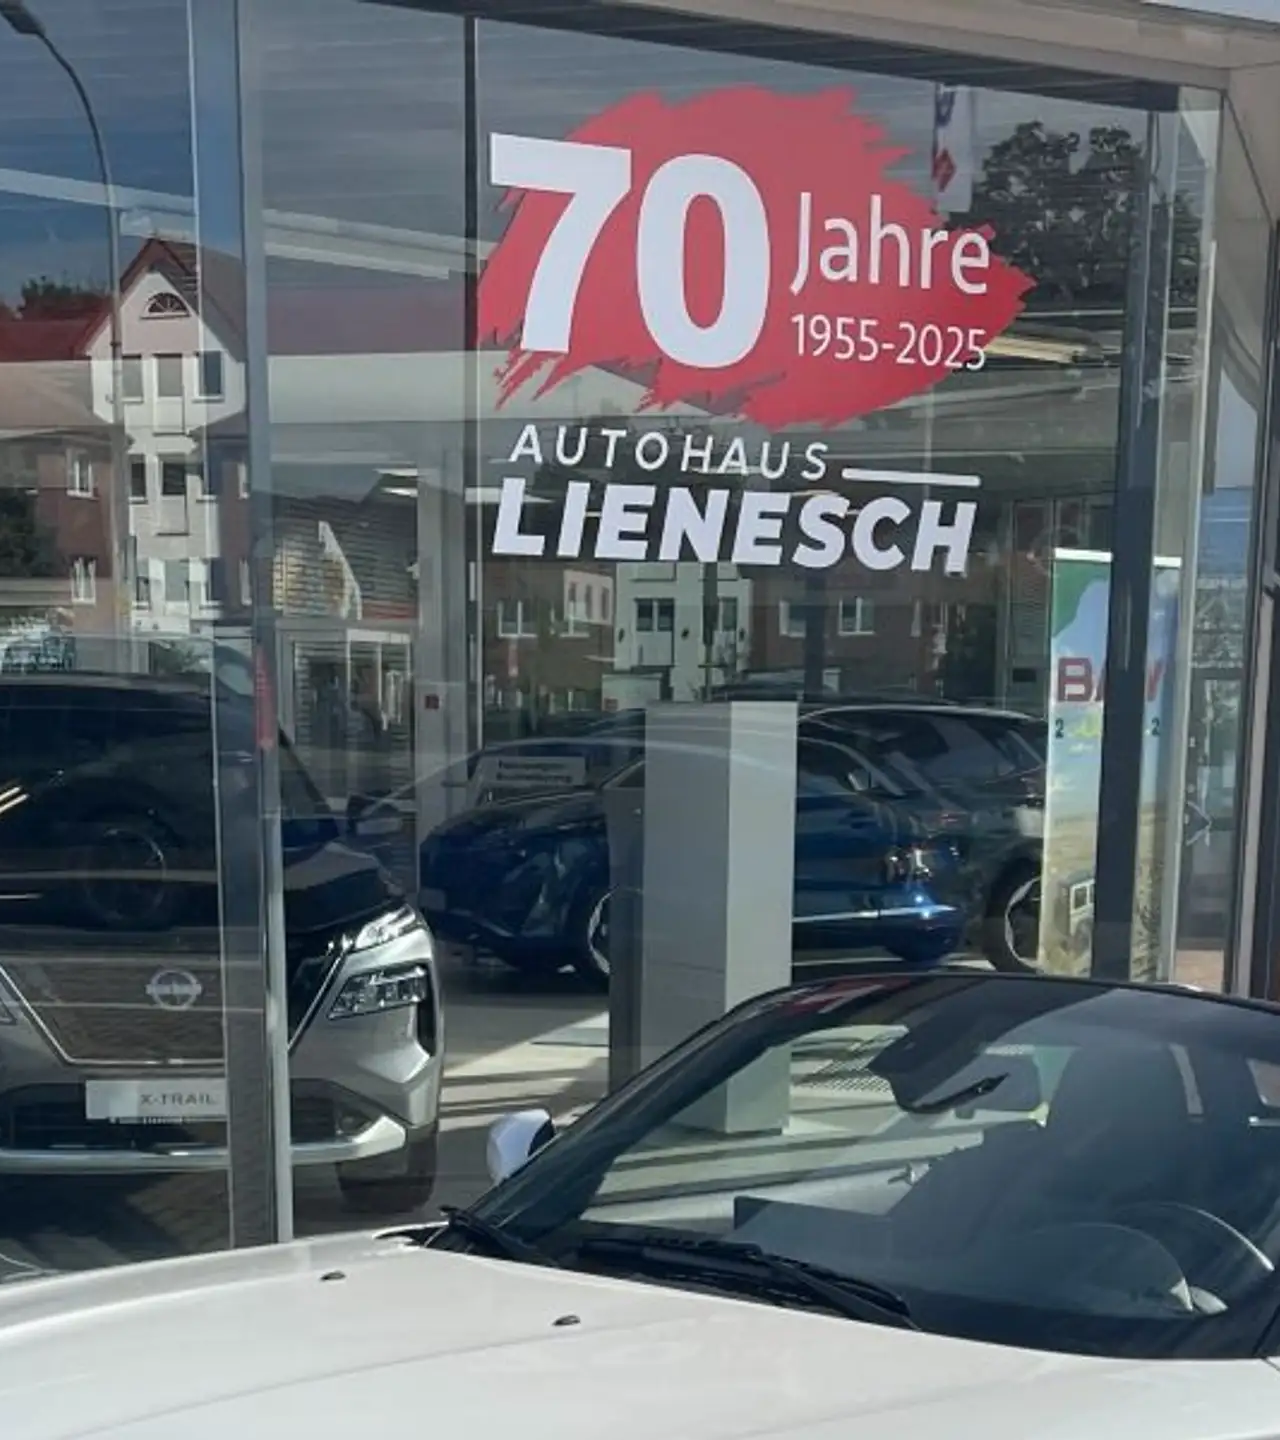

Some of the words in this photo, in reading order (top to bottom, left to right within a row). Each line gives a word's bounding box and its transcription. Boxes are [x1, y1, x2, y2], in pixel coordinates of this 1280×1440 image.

[490, 132, 770, 368] 70
[790, 192, 990, 295] Jahre
[791, 313, 986, 369] 1955-2025
[509, 424, 830, 480] AUTOHAUS
[492, 477, 977, 575] LIENESCH
